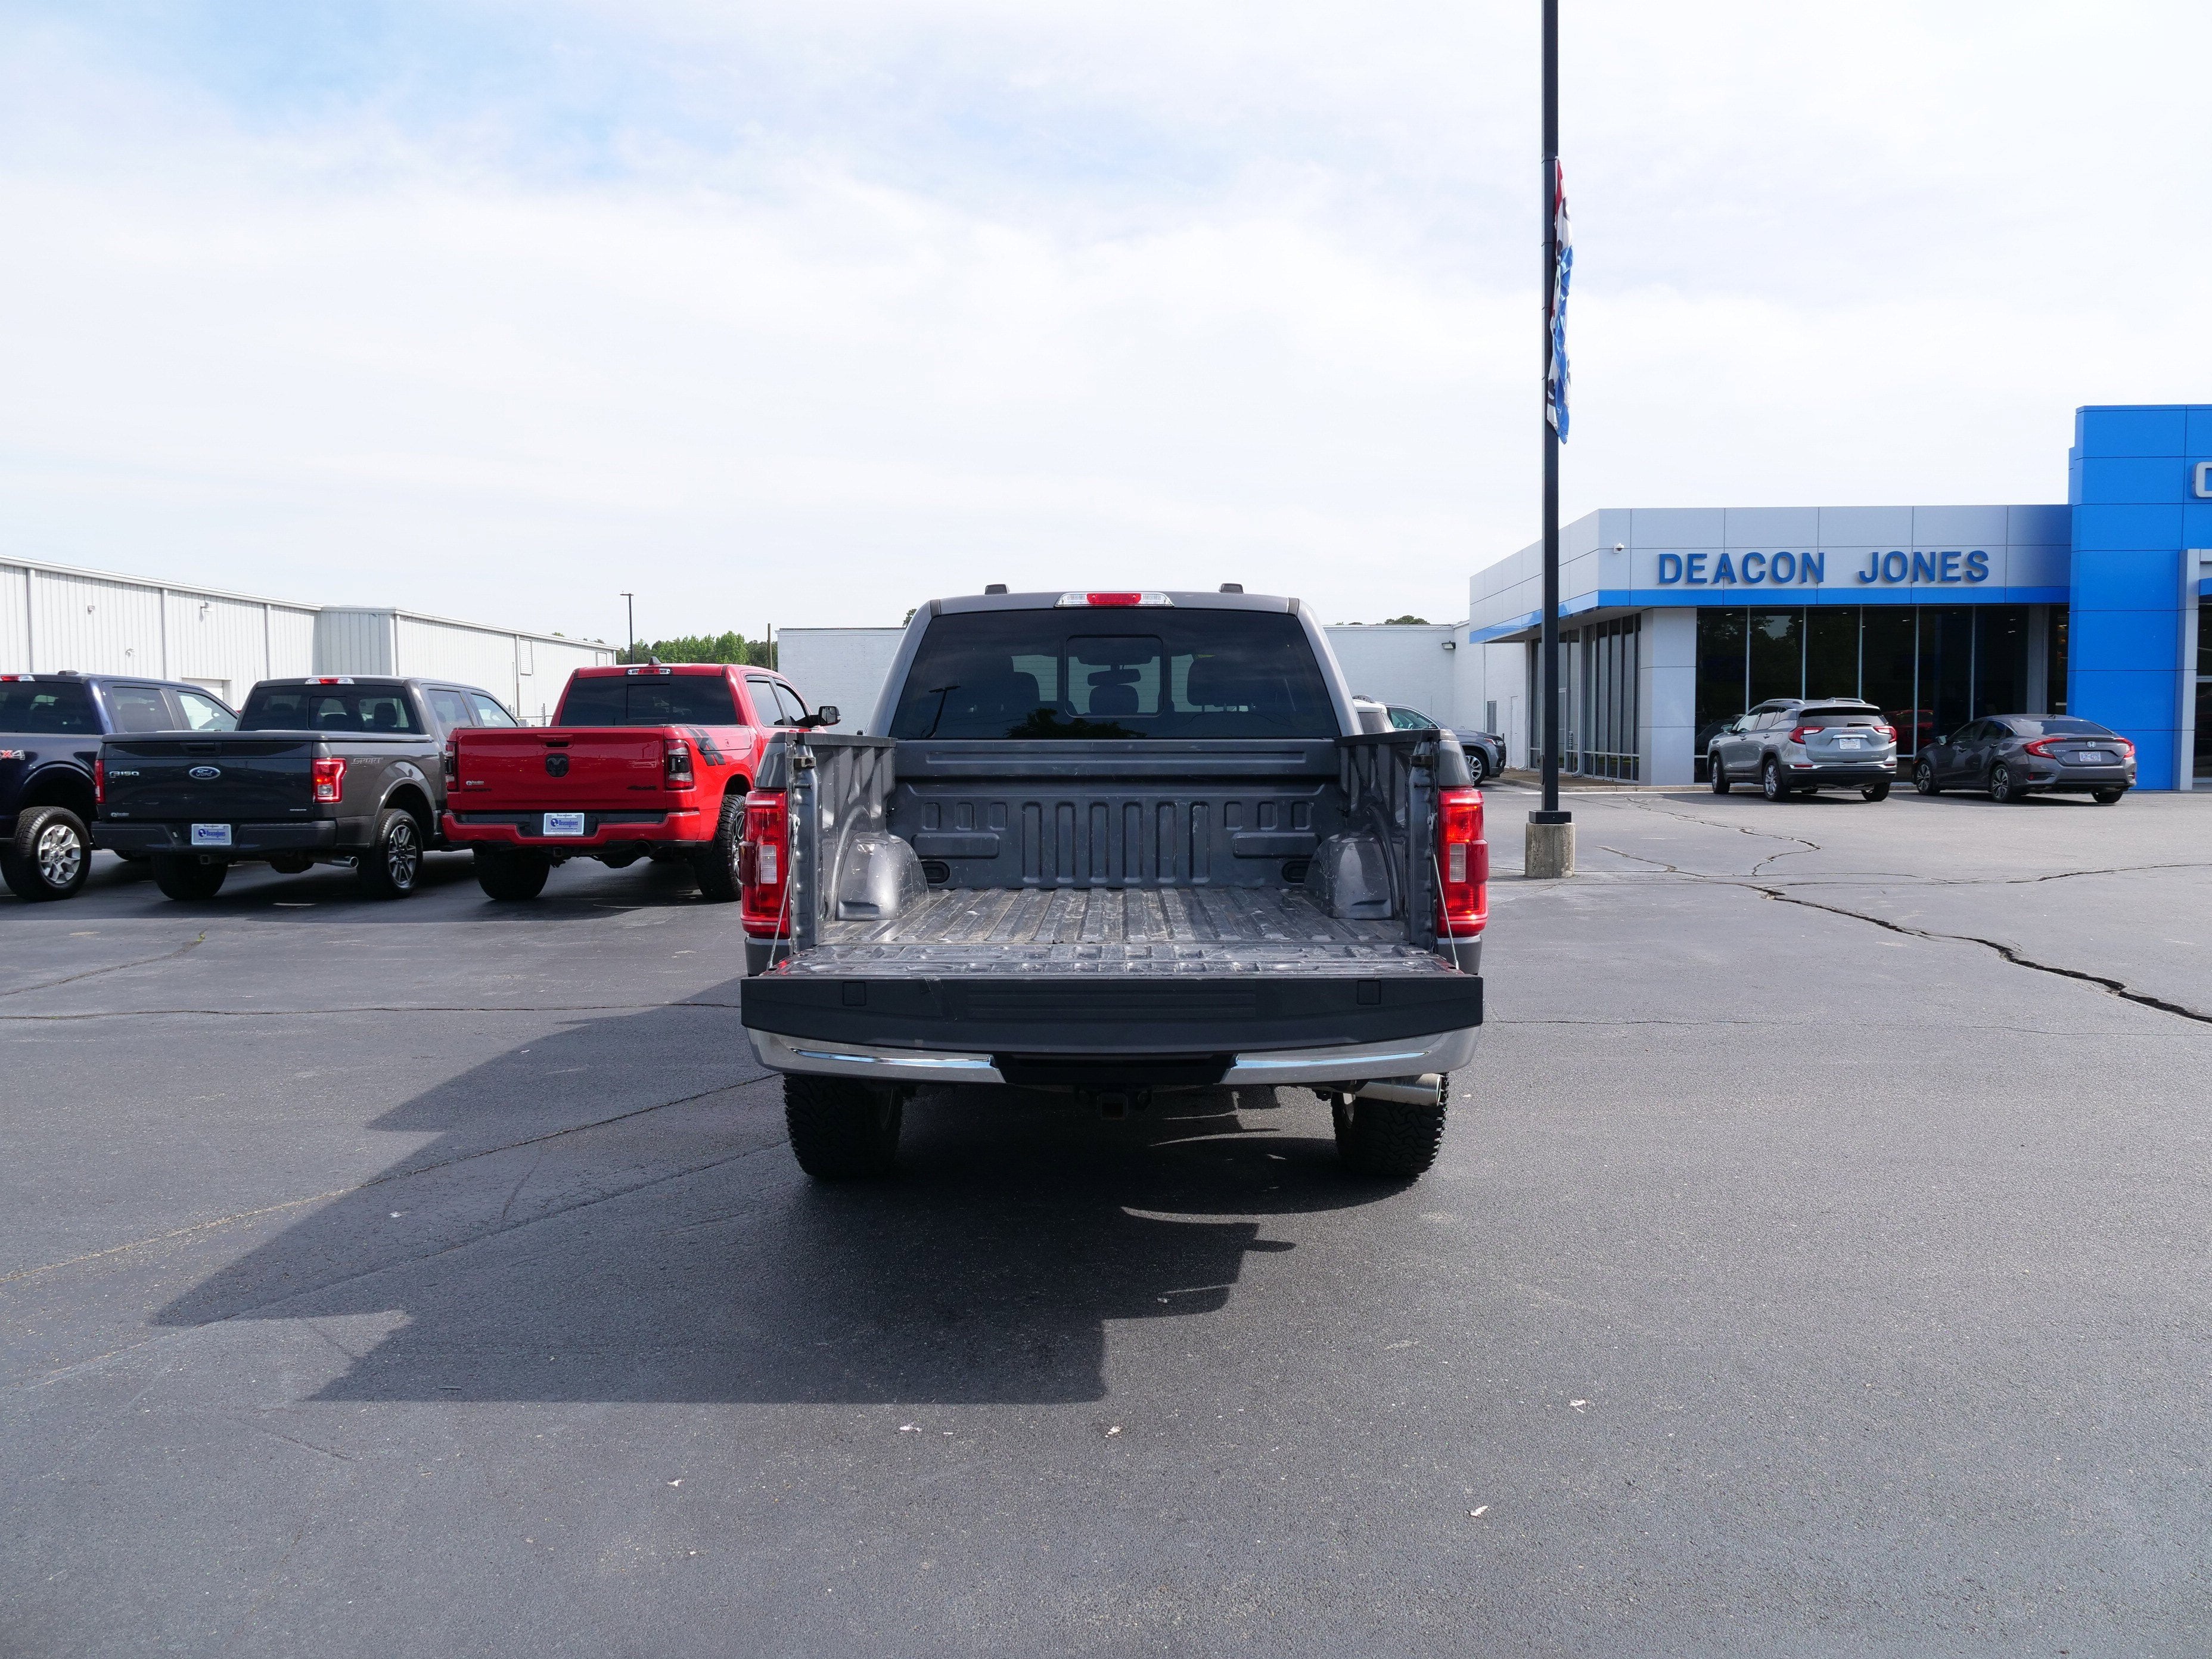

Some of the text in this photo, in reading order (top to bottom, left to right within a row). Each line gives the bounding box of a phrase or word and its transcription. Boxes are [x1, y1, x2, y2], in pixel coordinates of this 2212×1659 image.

[1658, 551, 1989, 585] DEACON JONES
[195, 769, 213, 777] Ford
